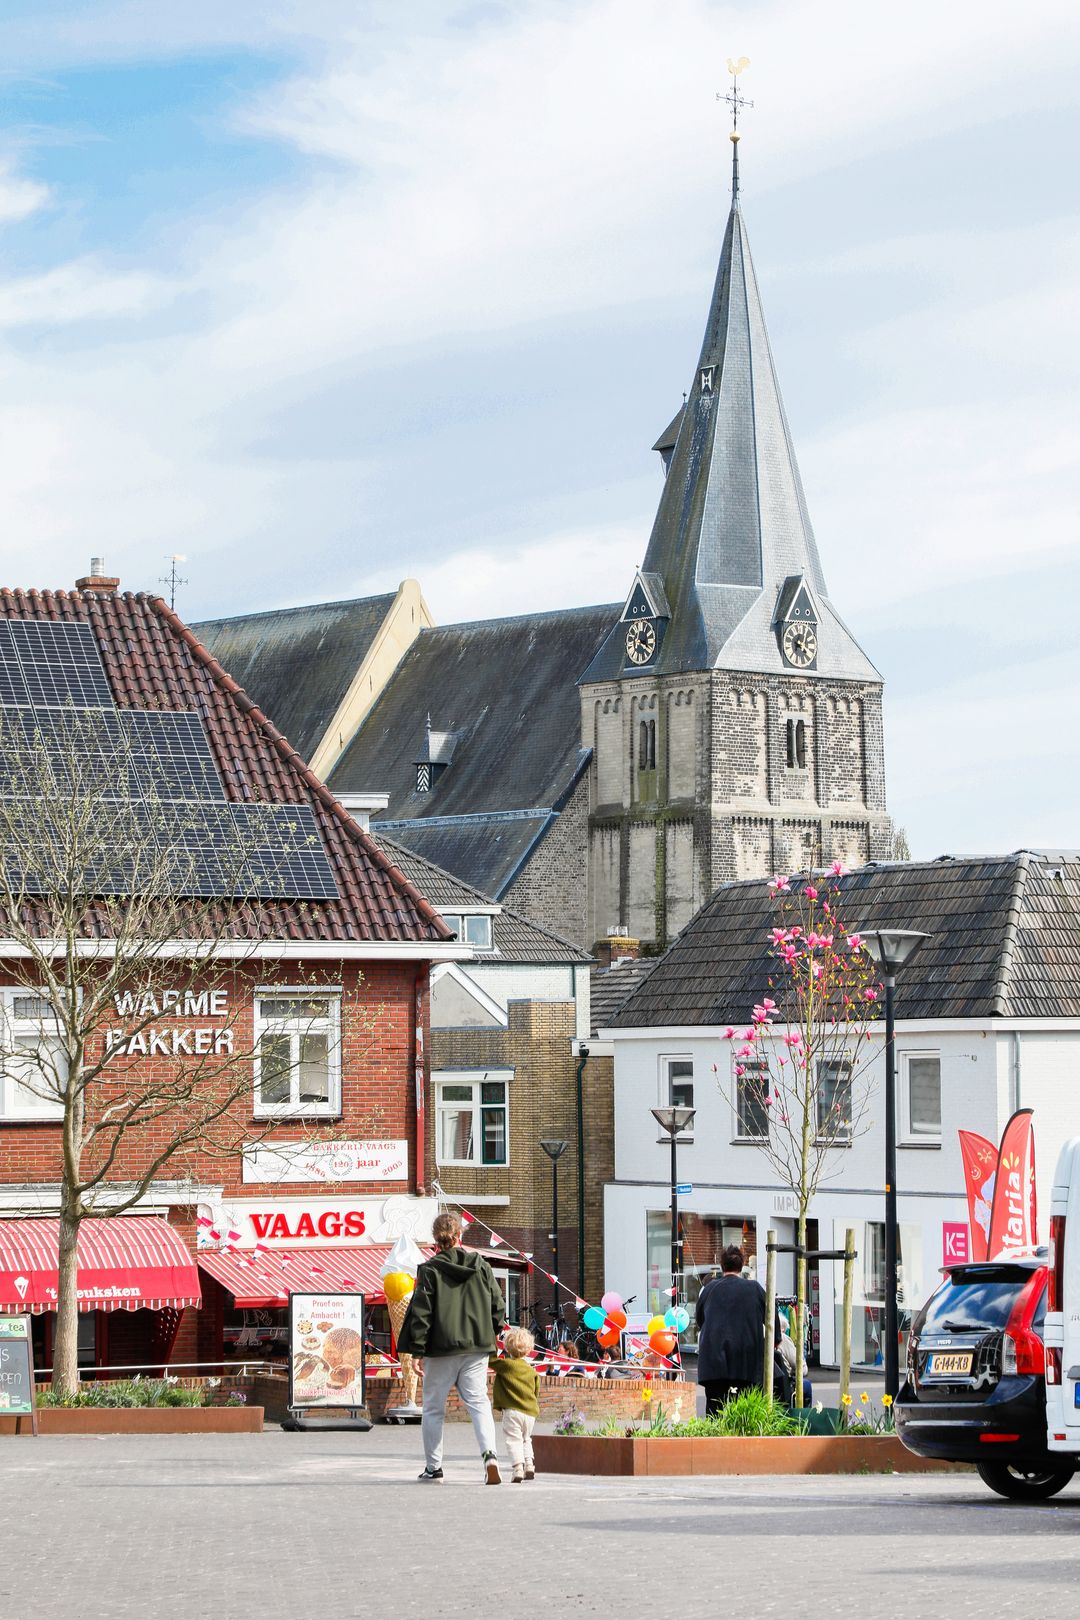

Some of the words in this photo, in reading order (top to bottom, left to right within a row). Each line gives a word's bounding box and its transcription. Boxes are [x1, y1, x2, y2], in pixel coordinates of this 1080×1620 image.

[113, 990, 229, 1015] WARME
[106, 1028, 234, 1055] BAKKER
[313, 1142, 363, 1151] BAKKERIJ
[366, 1142, 397, 1151] VAAGS
[333, 1160, 349, 1168] 120
[355, 1157, 381, 1169] jaar
[249, 1211, 366, 1239] VAAGS
[76, 1284, 141, 1299] euksken
[312, 1299, 331, 1308] Proef
[310, 1311, 340, 1320] Ambacht
[8, 1322, 25, 1332] tea
